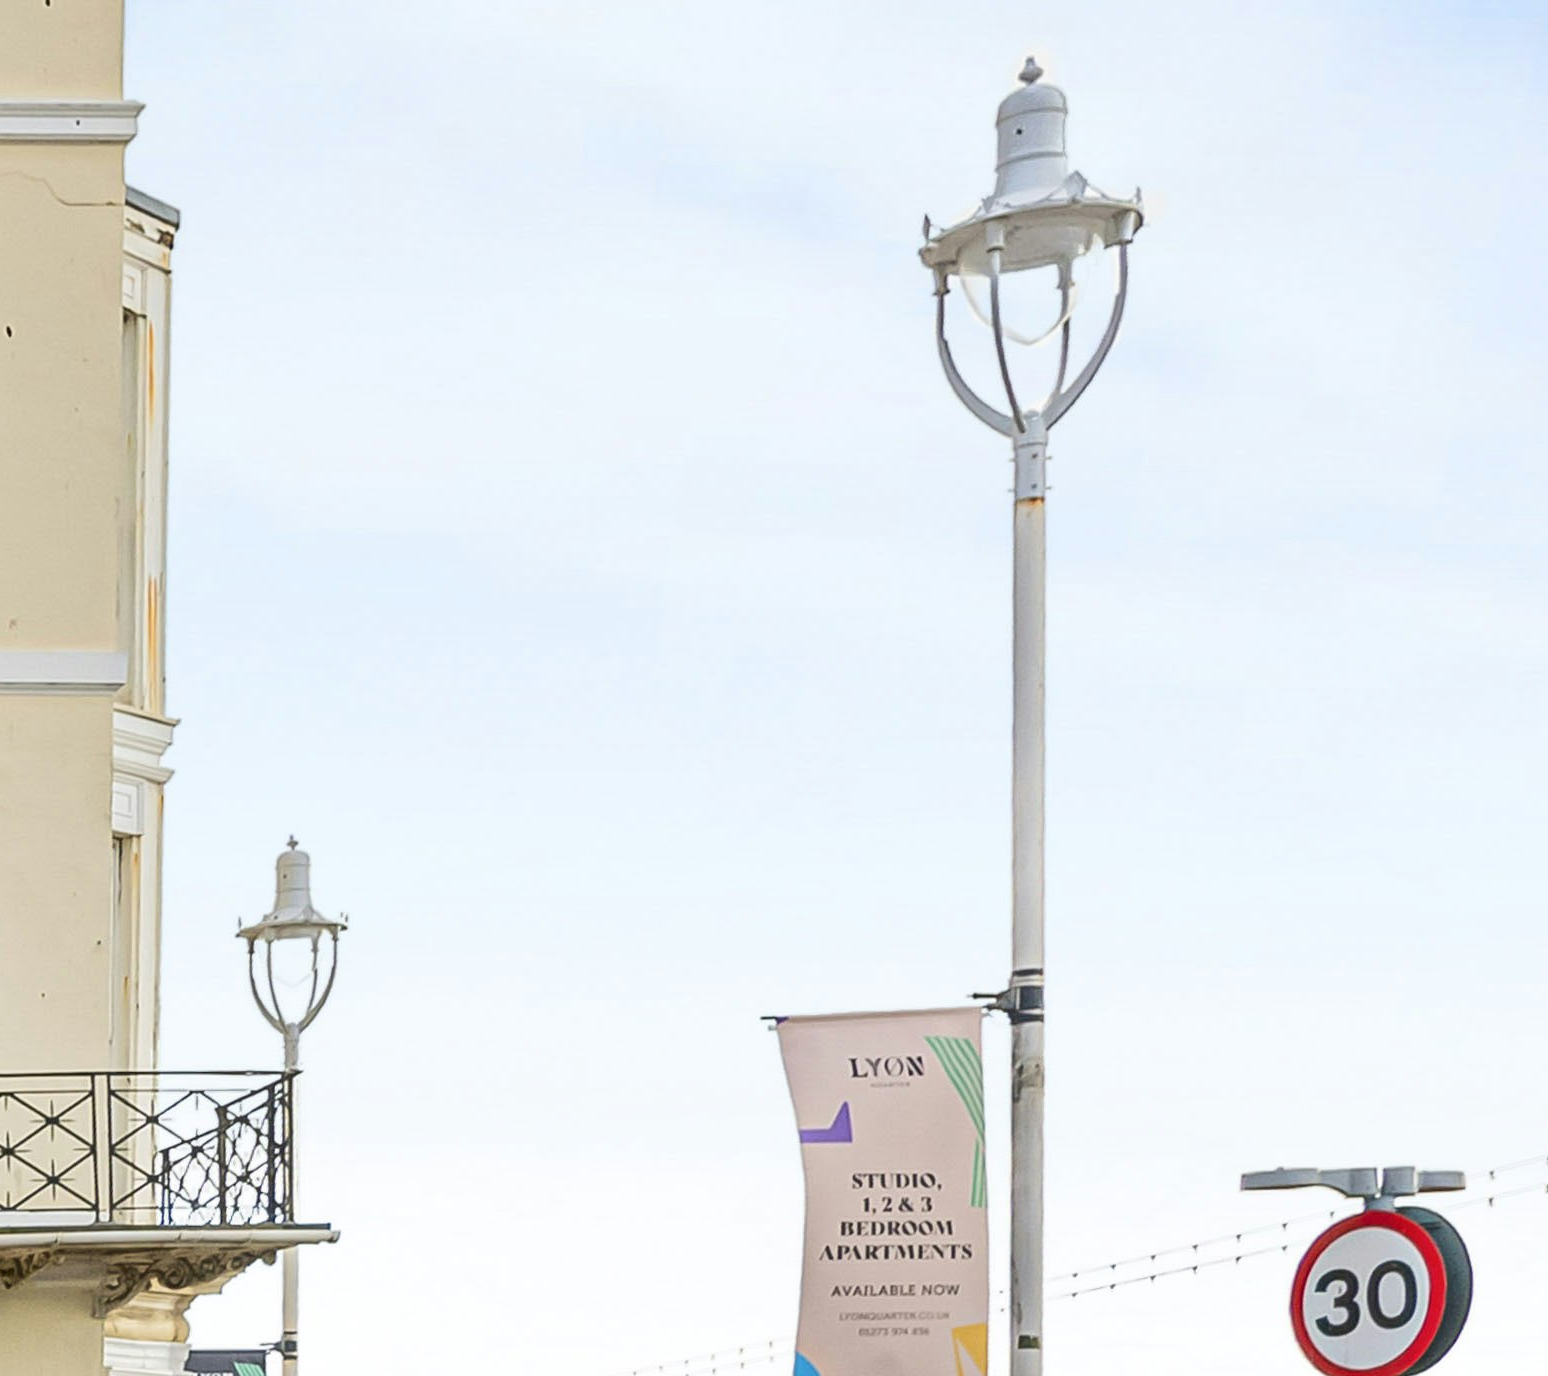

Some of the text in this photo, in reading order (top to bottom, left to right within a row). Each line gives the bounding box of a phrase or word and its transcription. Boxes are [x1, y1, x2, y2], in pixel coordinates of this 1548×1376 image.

[852, 1172, 943, 1190] STUDIO,
[863, 1196, 933, 1214] 1, 2 & 3
[840, 1220, 954, 1236] BEDROOM
[819, 1243, 973, 1261] APARTMENTS
[831, 1284, 961, 1297] AVAILABLE NOW
[1313, 1259, 1419, 1338] 30
